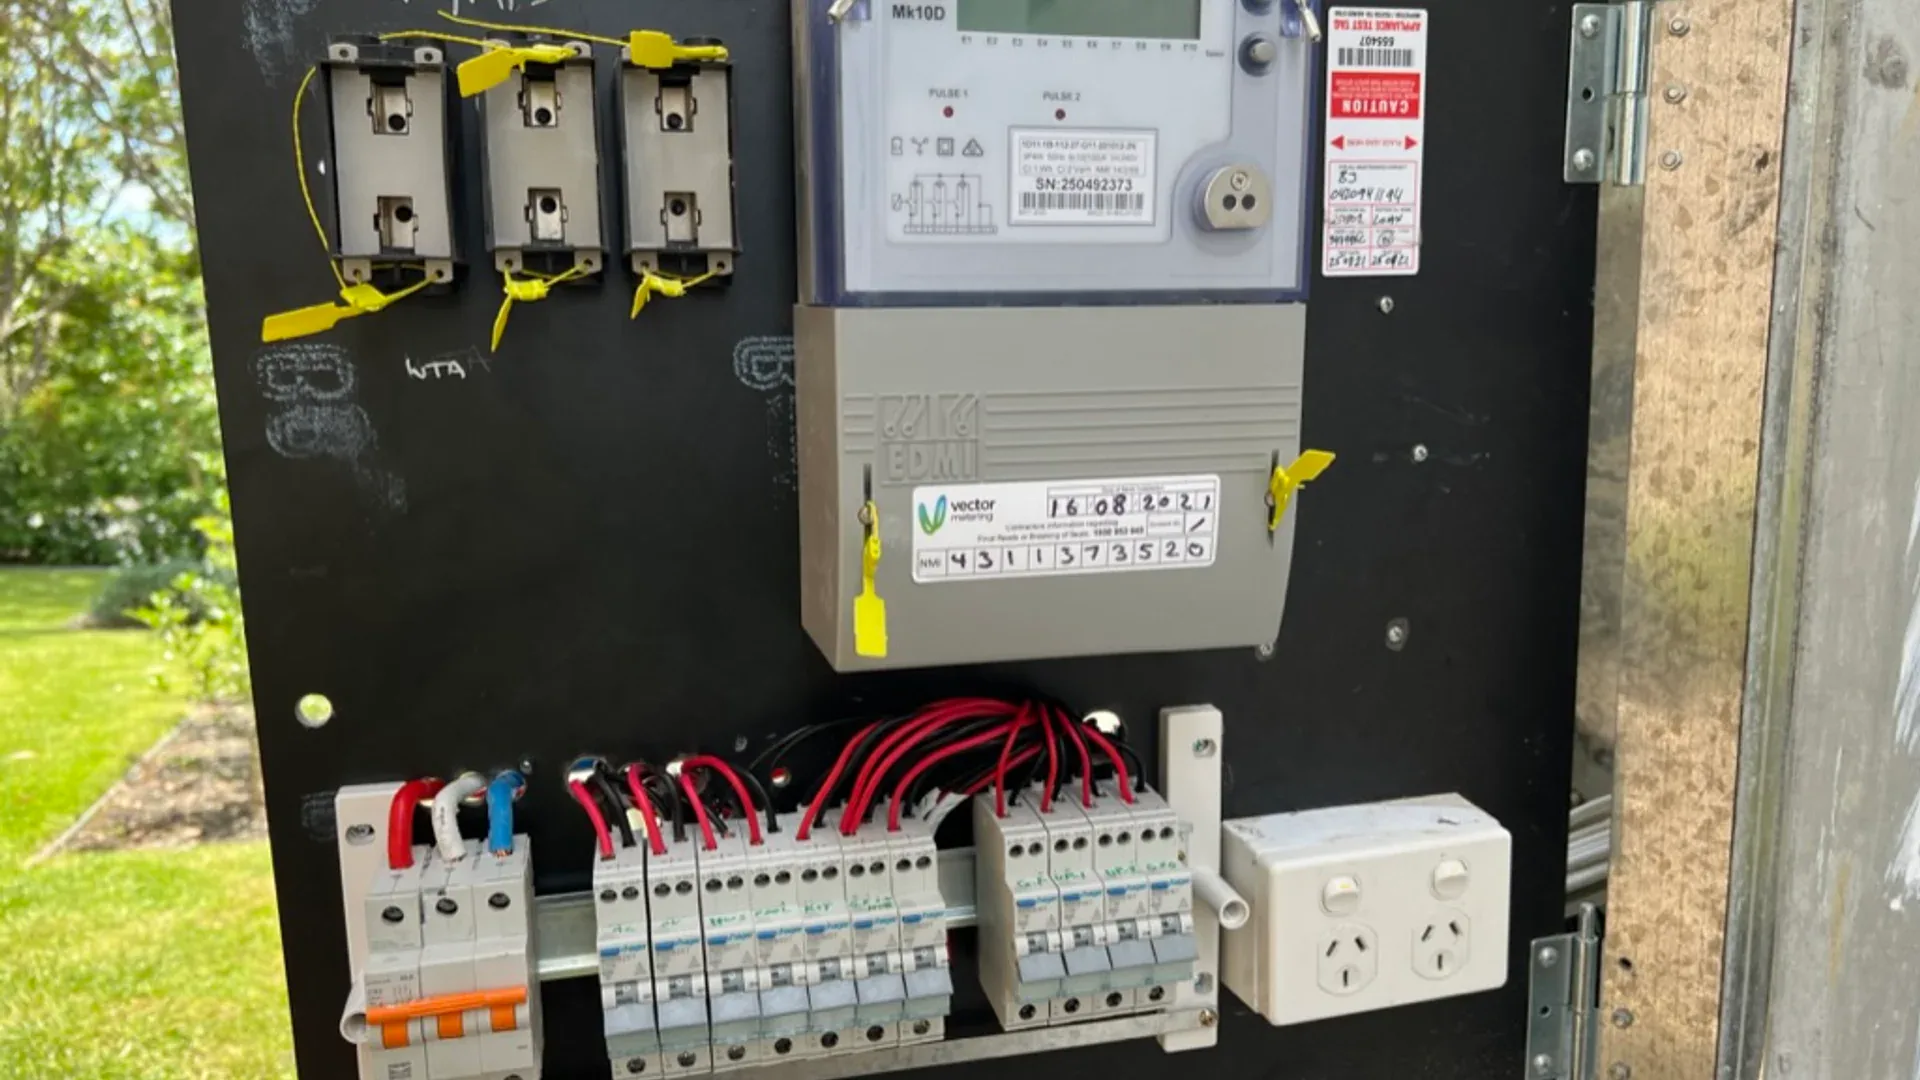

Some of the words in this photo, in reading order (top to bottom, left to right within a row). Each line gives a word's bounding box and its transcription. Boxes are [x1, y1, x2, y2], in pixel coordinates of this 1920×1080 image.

[892, 5, 945, 20] Mk10D
[1334, 19, 1350, 30] TAG
[1353, 19, 1373, 30] TEST
[1376, 20, 1421, 32] APPLIANCE
[929, 89, 960, 98] PULSE
[1342, 100, 1409, 114] CAUTION
[888, 444, 973, 480] EDMI
[951, 499, 996, 511] vector
[951, 512, 993, 523] metering
[920, 559, 941, 568] NMI
